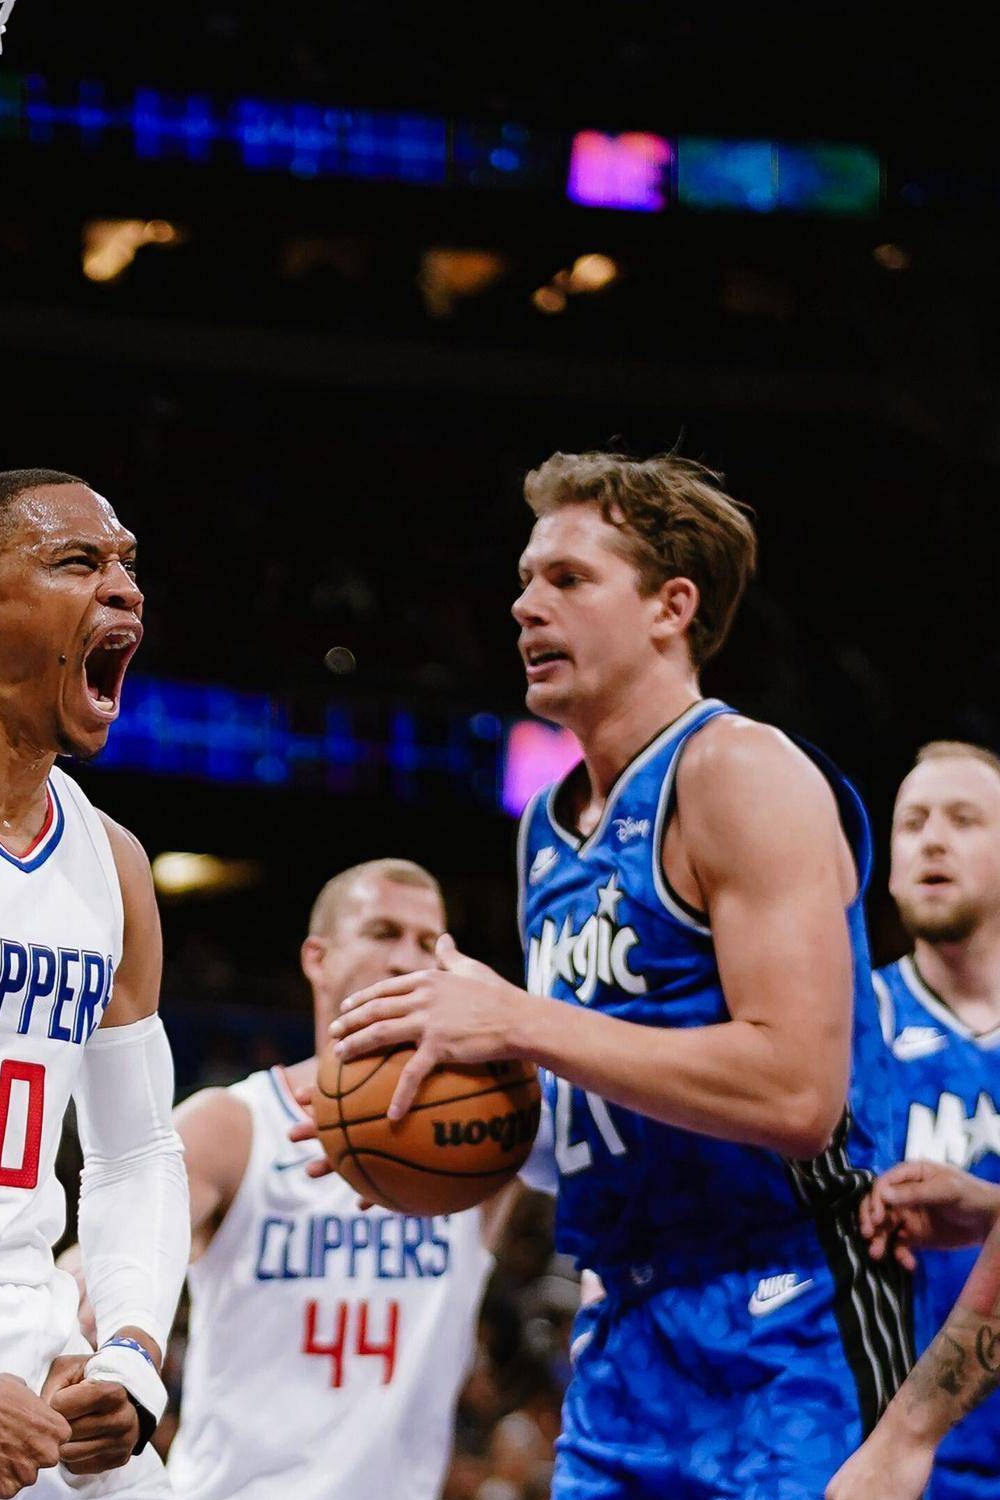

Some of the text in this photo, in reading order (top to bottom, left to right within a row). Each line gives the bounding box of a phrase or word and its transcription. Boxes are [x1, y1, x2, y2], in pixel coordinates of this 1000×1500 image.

[256, 1214, 452, 1281] CLIPPERS
[757, 1273, 797, 1299] NIKE
[302, 1299, 399, 1388] 44
